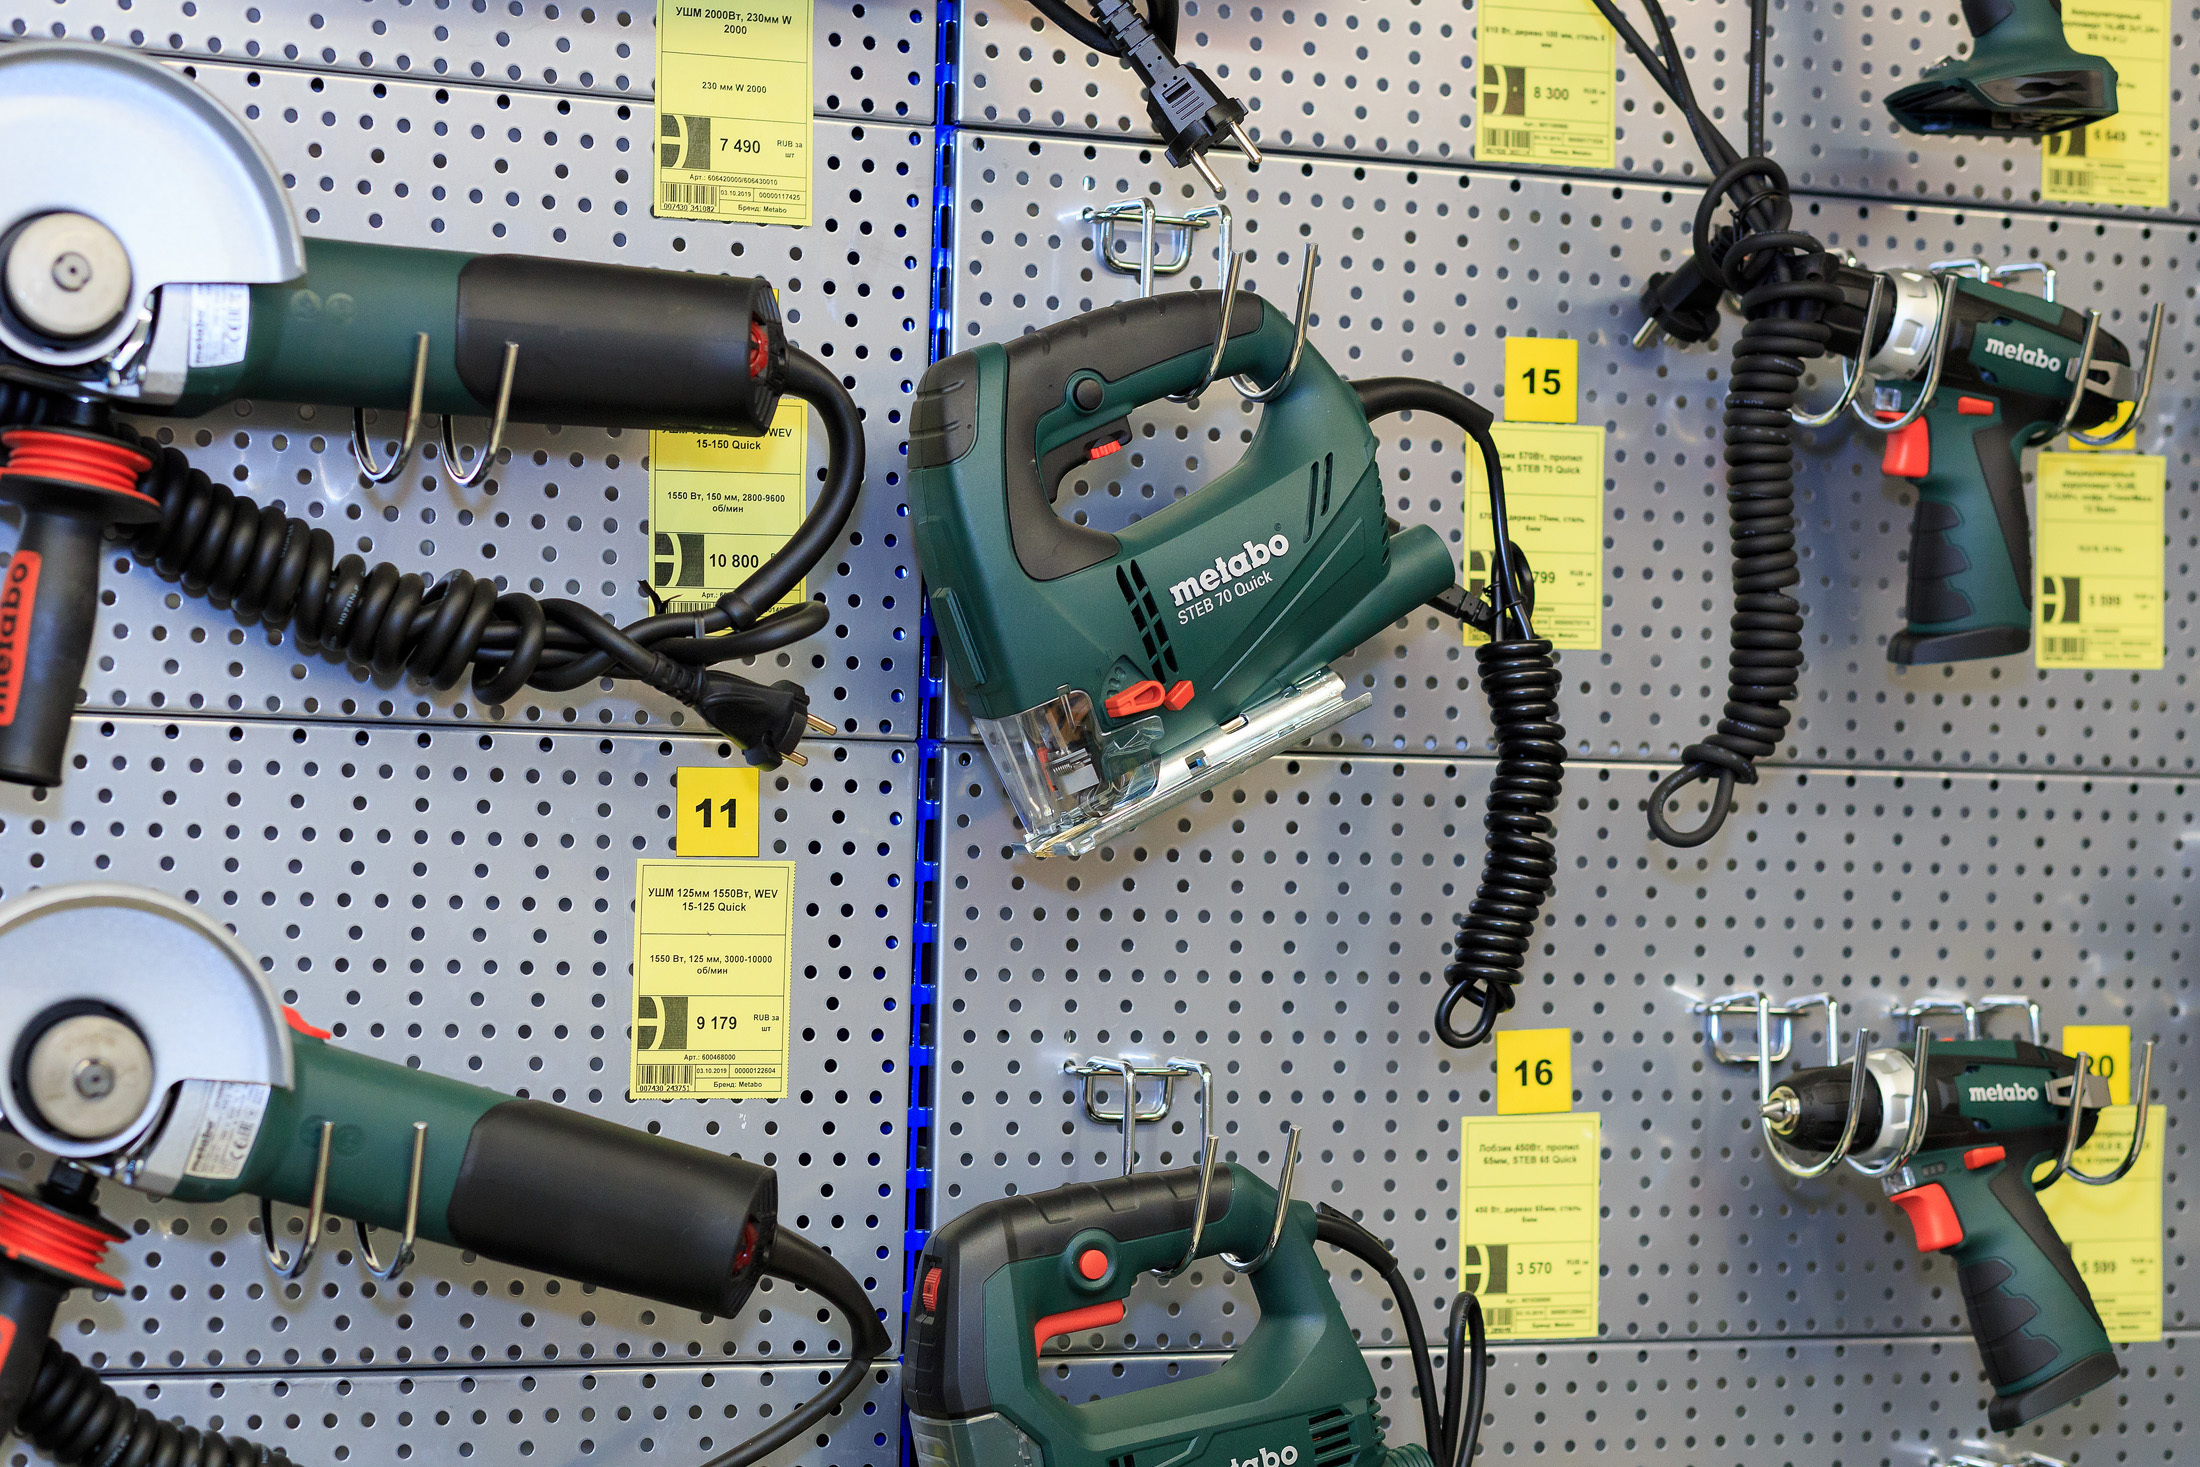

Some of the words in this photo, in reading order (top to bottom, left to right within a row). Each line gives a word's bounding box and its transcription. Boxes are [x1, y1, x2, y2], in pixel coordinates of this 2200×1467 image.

[676, 7, 702, 17] УШМ
[704, 9, 744, 23] 2000Вт,
[747, 13, 779, 24] 230мм
[782, 15, 792, 25] W
[724, 25, 747, 35] 2000
[702, 82, 717, 90] 230
[735, 84, 744, 92] W
[747, 85, 767, 93] 2000
[1534, 86, 1541, 99] 8
[1546, 87, 1569, 100] 300
[720, 138, 728, 151] 7
[734, 139, 761, 153] 490
[777, 140, 793, 148] RUB
[690, 174, 706, 182] Арт.:
[738, 204, 761, 212] Бренд:
[1984, 337, 2061, 372] metabo
[1523, 368, 1561, 395] 15
[769, 428, 792, 437] WEV
[697, 439, 729, 448] 15-150
[732, 441, 761, 450] Quick
[667, 492, 687, 500] 1550
[690, 492, 704, 501] Вт,
[742, 494, 785, 502] 2800-9600
[712, 505, 744, 513] об/мин
[709, 554, 726, 567] 10
[732, 554, 759, 568] 800
[1169, 534, 1289, 606] metabo
[1533, 571, 1555, 584] 799
[1178, 598, 1214, 625] STEB
[1215, 588, 1233, 607] 70
[1234, 570, 1273, 597] Quick
[696, 798, 736, 828] 11
[648, 888, 674, 897] УШМ
[677, 889, 710, 897] 125мм
[714, 889, 751, 899] 1550Вт,
[754, 890, 778, 898] WEV
[682, 903, 714, 911] 15-125
[718, 903, 746, 912] Quick
[673, 955, 686, 964] Вт,
[689, 955, 704, 963] 125
[725, 955, 772, 963] 3000-10000
[697, 1016, 705, 1030] 9
[711, 1016, 737, 1030] 179
[1515, 1059, 1553, 1086] 16
[1969, 1083, 2039, 1102] metabo
[1516, 1262, 1524, 1275] 3
[1529, 1262, 1552, 1274] 570
